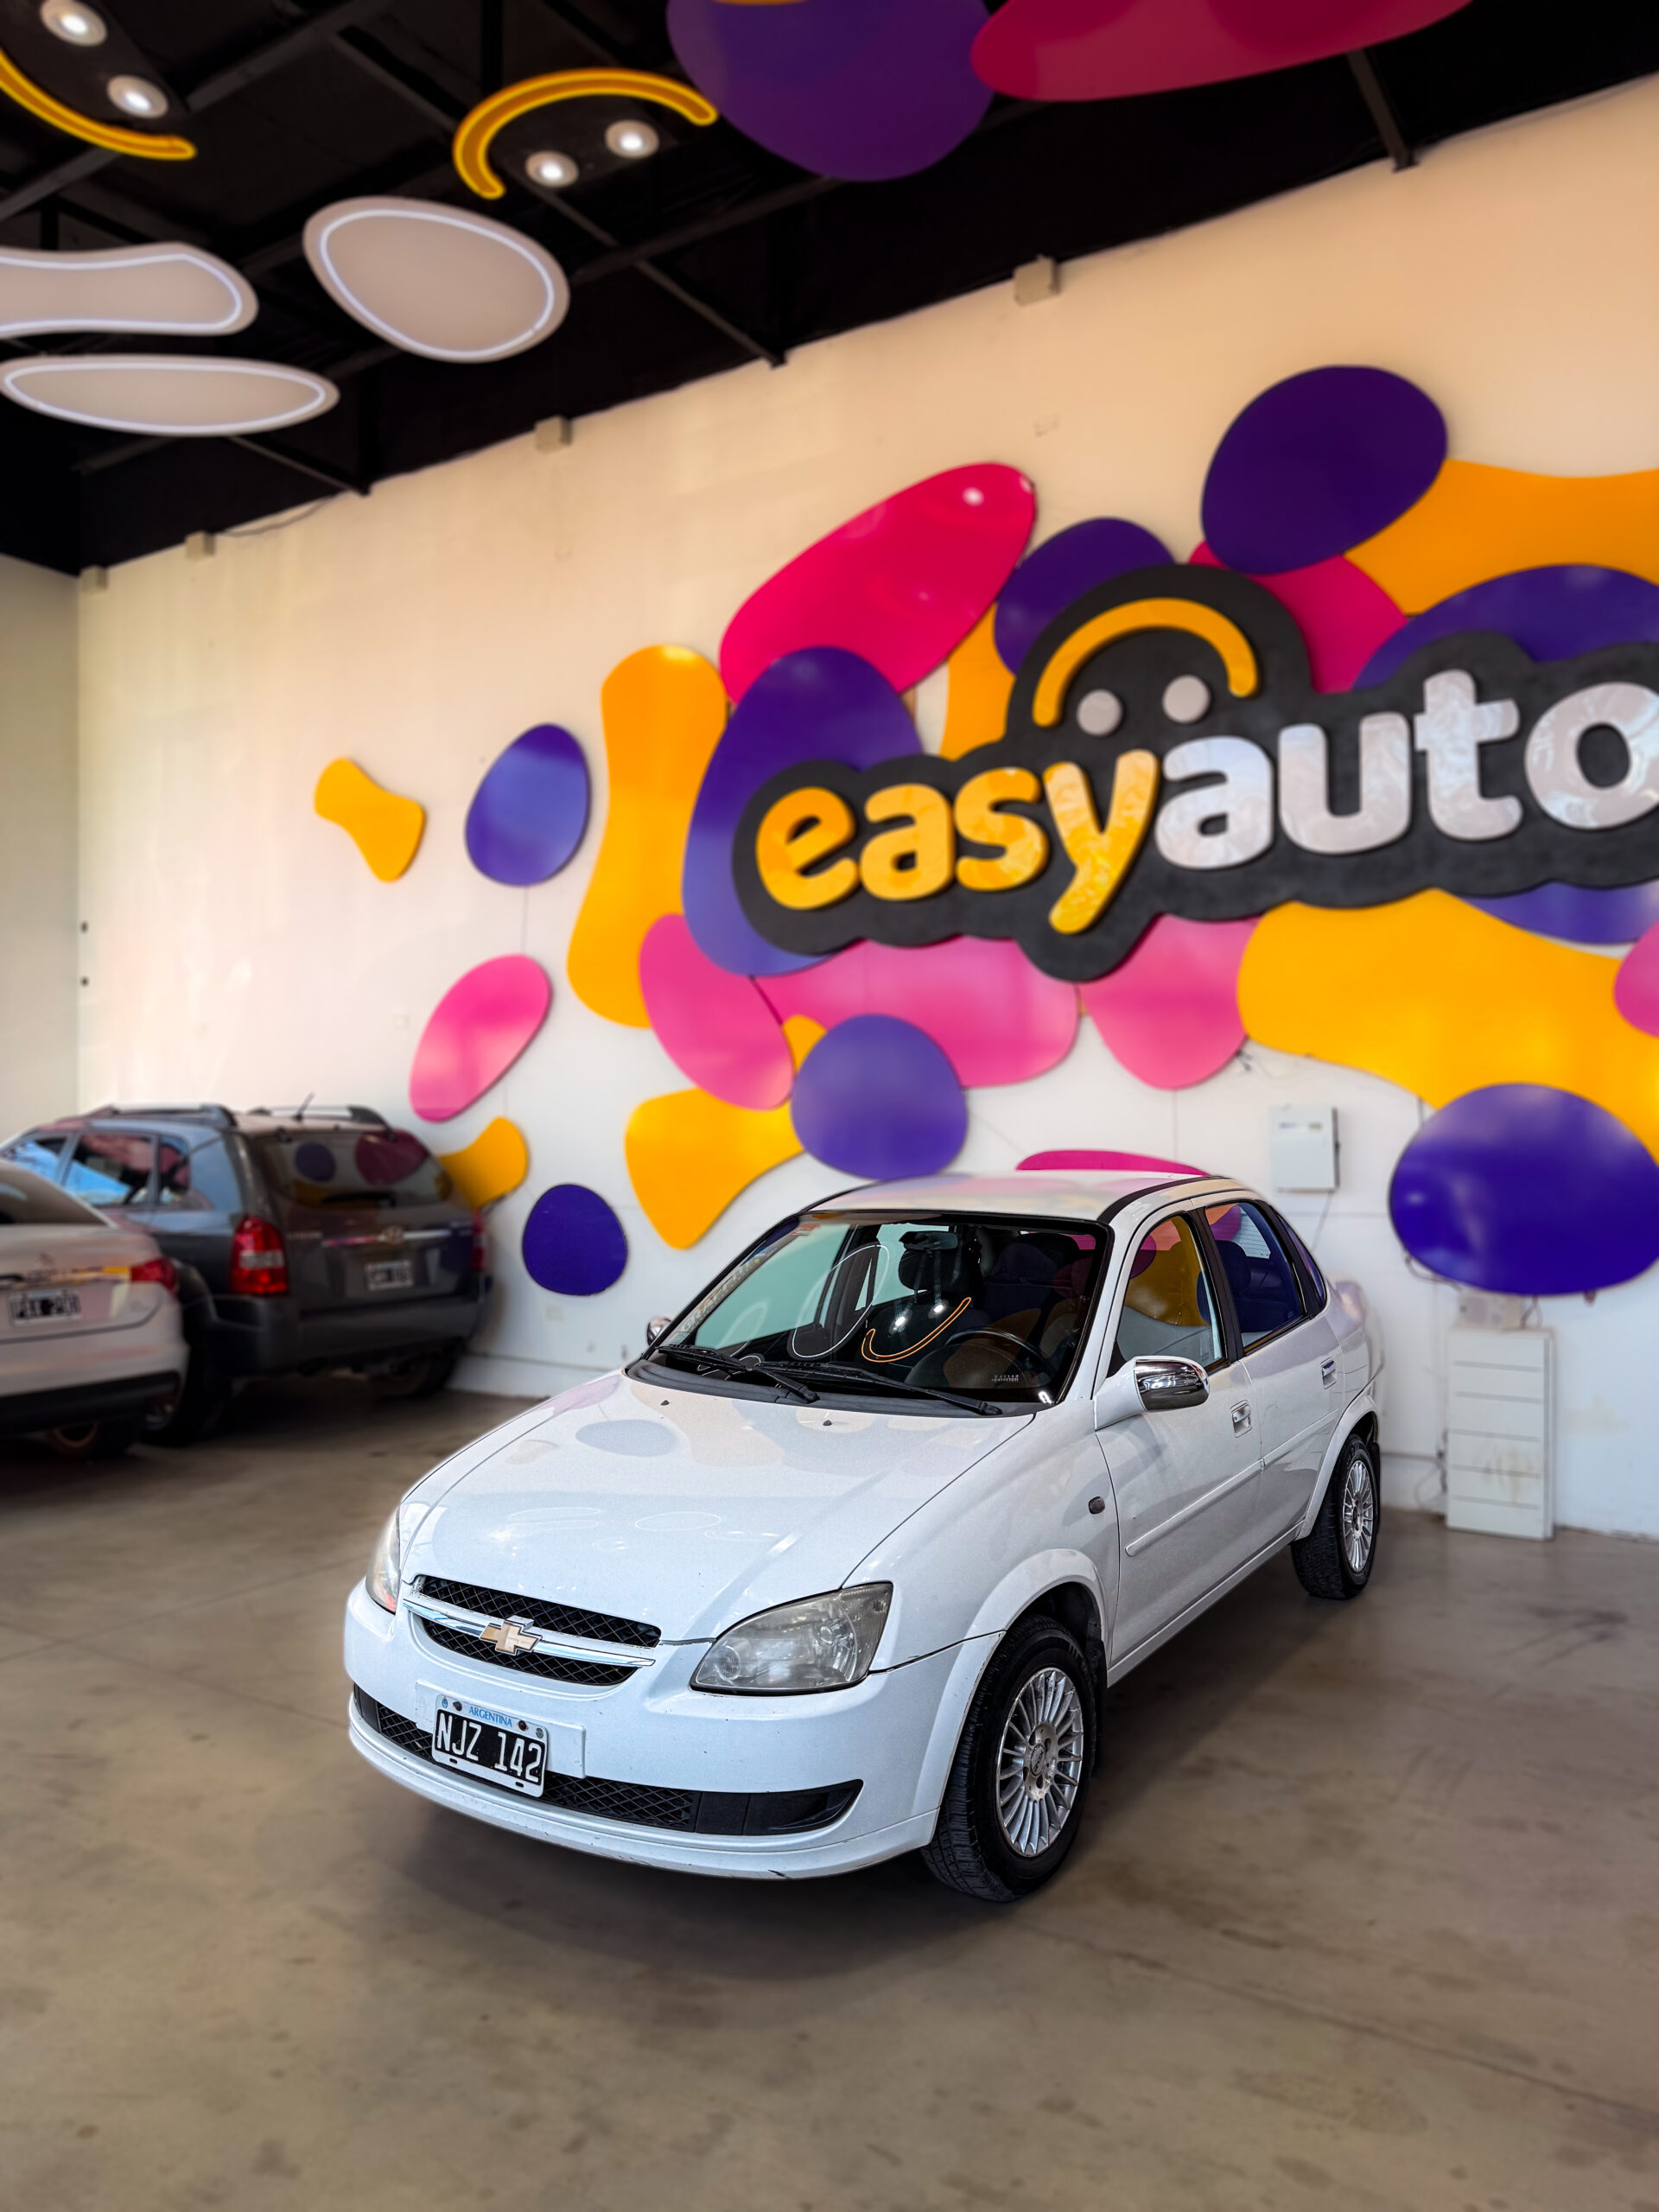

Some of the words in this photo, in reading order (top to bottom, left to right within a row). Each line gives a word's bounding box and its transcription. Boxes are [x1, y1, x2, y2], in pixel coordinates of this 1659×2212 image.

[468, 1706, 512, 1727] ARGENTINA
[436, 1712, 482, 1761] NJZ
[494, 1731, 542, 1783] 142
